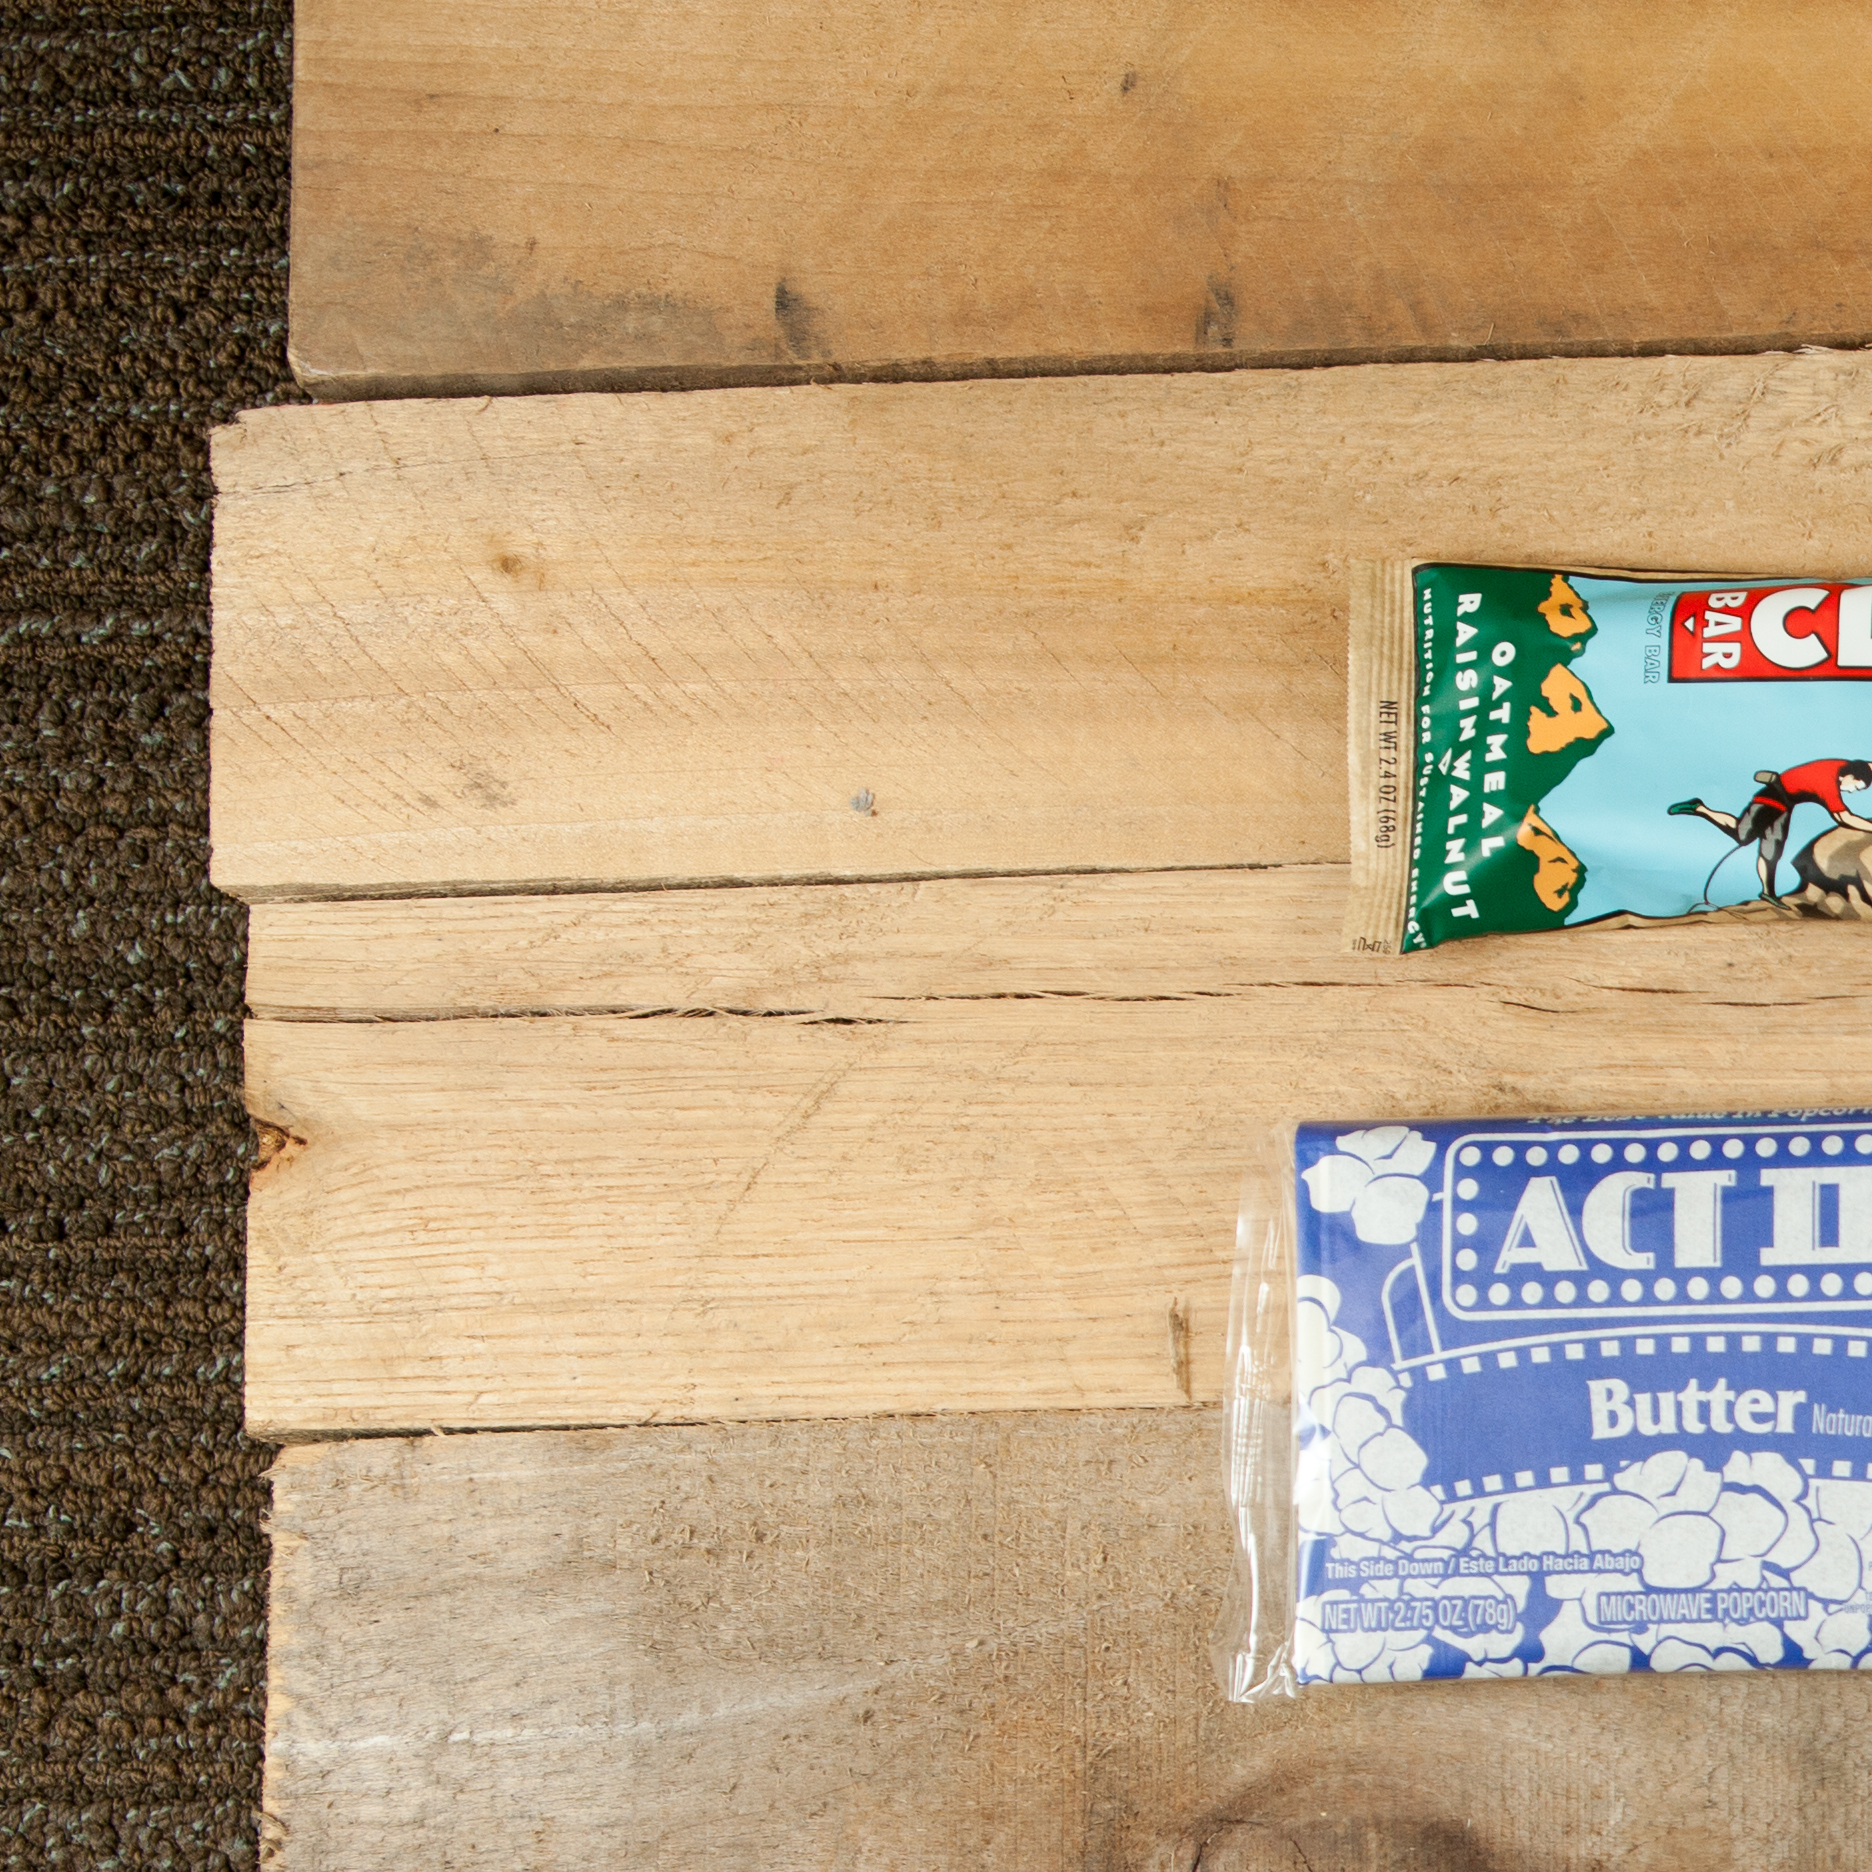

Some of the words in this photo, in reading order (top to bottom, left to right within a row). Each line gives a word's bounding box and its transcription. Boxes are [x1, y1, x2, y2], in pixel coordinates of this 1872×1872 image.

[1422, 588, 1435, 697] NUTRITION
[1701, 590, 1748, 671] BAR
[1455, 593, 1482, 742] RAISIN
[1643, 645, 1661, 684] BAR
[1379, 700, 1398, 726] NET
[1420, 705, 1432, 744] FOR
[1379, 732, 1398, 753] WT
[1481, 641, 1516, 857] OATMEAL
[1379, 757, 1398, 779] 2.4
[1379, 784, 1397, 804] OZ
[1413, 752, 1434, 860] SUSTAINED
[1375, 809, 1397, 849] (68g)
[1442, 749, 1480, 919] WALNUT
[1494, 1170, 1737, 1273] ACT
[1586, 1377, 1807, 1440] Butter
[1326, 1562, 1357, 1579] This
[1360, 1560, 1394, 1576] Side
[1398, 1559, 1443, 1575] Down
[1459, 1557, 1494, 1573] Este
[1499, 1555, 1539, 1572] Lado
[1542, 1554, 1590, 1571] Hacia
[1592, 1553, 1642, 1572] Abajo
[1324, 1602, 1357, 1630] NET
[1361, 1601, 1389, 1629] WT
[1394, 1600, 1435, 1627] 2.75
[1439, 1599, 1464, 1627] OZ
[1468, 1597, 1514, 1631] (78g)
[1600, 1592, 1713, 1622] MICROWAVE
[1717, 1590, 1807, 1619] POPCORN
